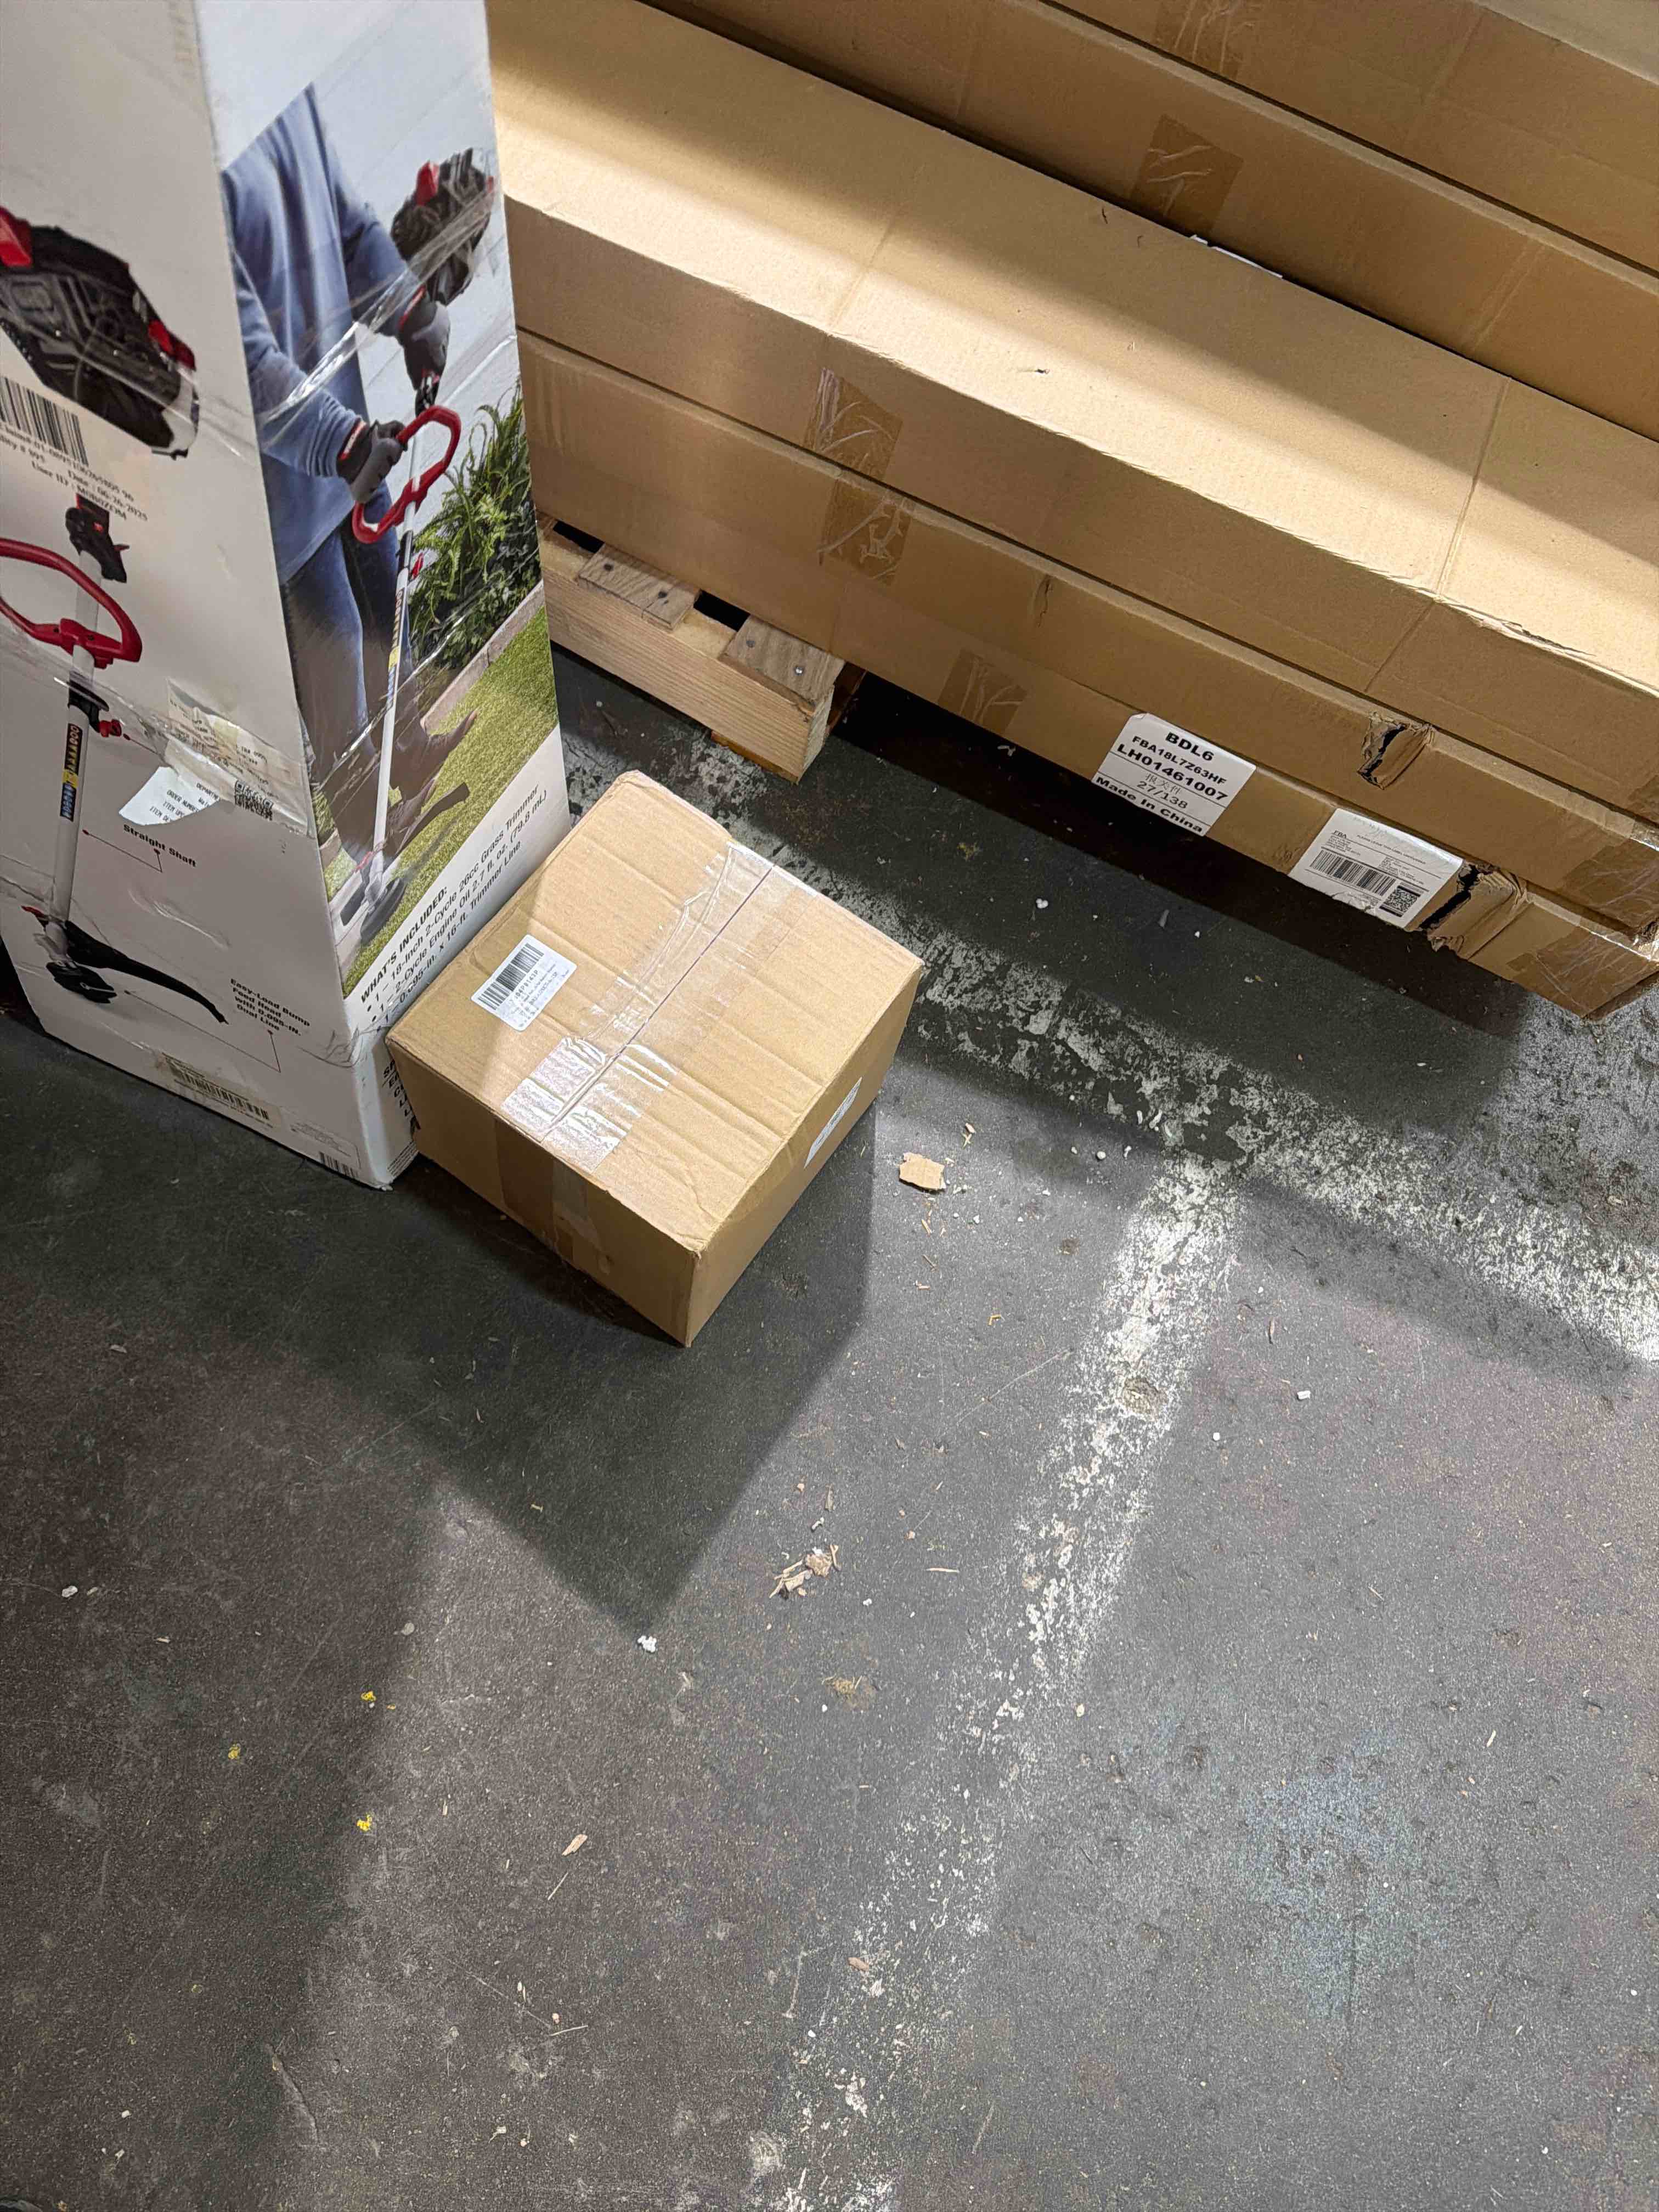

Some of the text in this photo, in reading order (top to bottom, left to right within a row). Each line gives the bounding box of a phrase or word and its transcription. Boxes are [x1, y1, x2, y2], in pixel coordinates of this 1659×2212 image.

[1132, 736, 1227, 785] FBA18L7Z63HF
[1165, 732, 1215, 761] BDL6
[1117, 744, 1228, 800] LH01461007
[150, 806, 162, 817] ITEM
[163, 801, 176, 813] ITEM
[167, 789, 182, 803] ORDER
[1096, 776, 1136, 801] Made
[1160, 809, 1203, 833] China
[1137, 781, 1188, 809] 27/138
[123, 824, 196, 867] Straight Shaft
[1334, 830, 1347, 838] FBA
[426, 891, 457, 937] 2-Cycle
[459, 862, 479, 892] 26cc
[481, 830, 504, 863] Grass
[505, 784, 539, 830] Trimmer
[395, 947, 427, 993] 2-Cycle
[429, 909, 457, 949] Engine
[460, 889, 470, 909] Oil
[472, 870, 485, 892] 2.7
[496, 844, 507, 860] oz.
[510, 811, 530, 843] (79.8
[532, 789, 546, 814] mL)
[447, 912, 468, 942] 16-ft.
[470, 864, 503, 911] Trimmer
[505, 841, 521, 866] Line
[361, 886, 448, 1003] WHAT'S INCLUDED:
[231, 979, 310, 1026] Easy-Load Bump
[233, 988, 281, 1018] Feed Head
[237, 1003, 280, 1031] Dual Line
